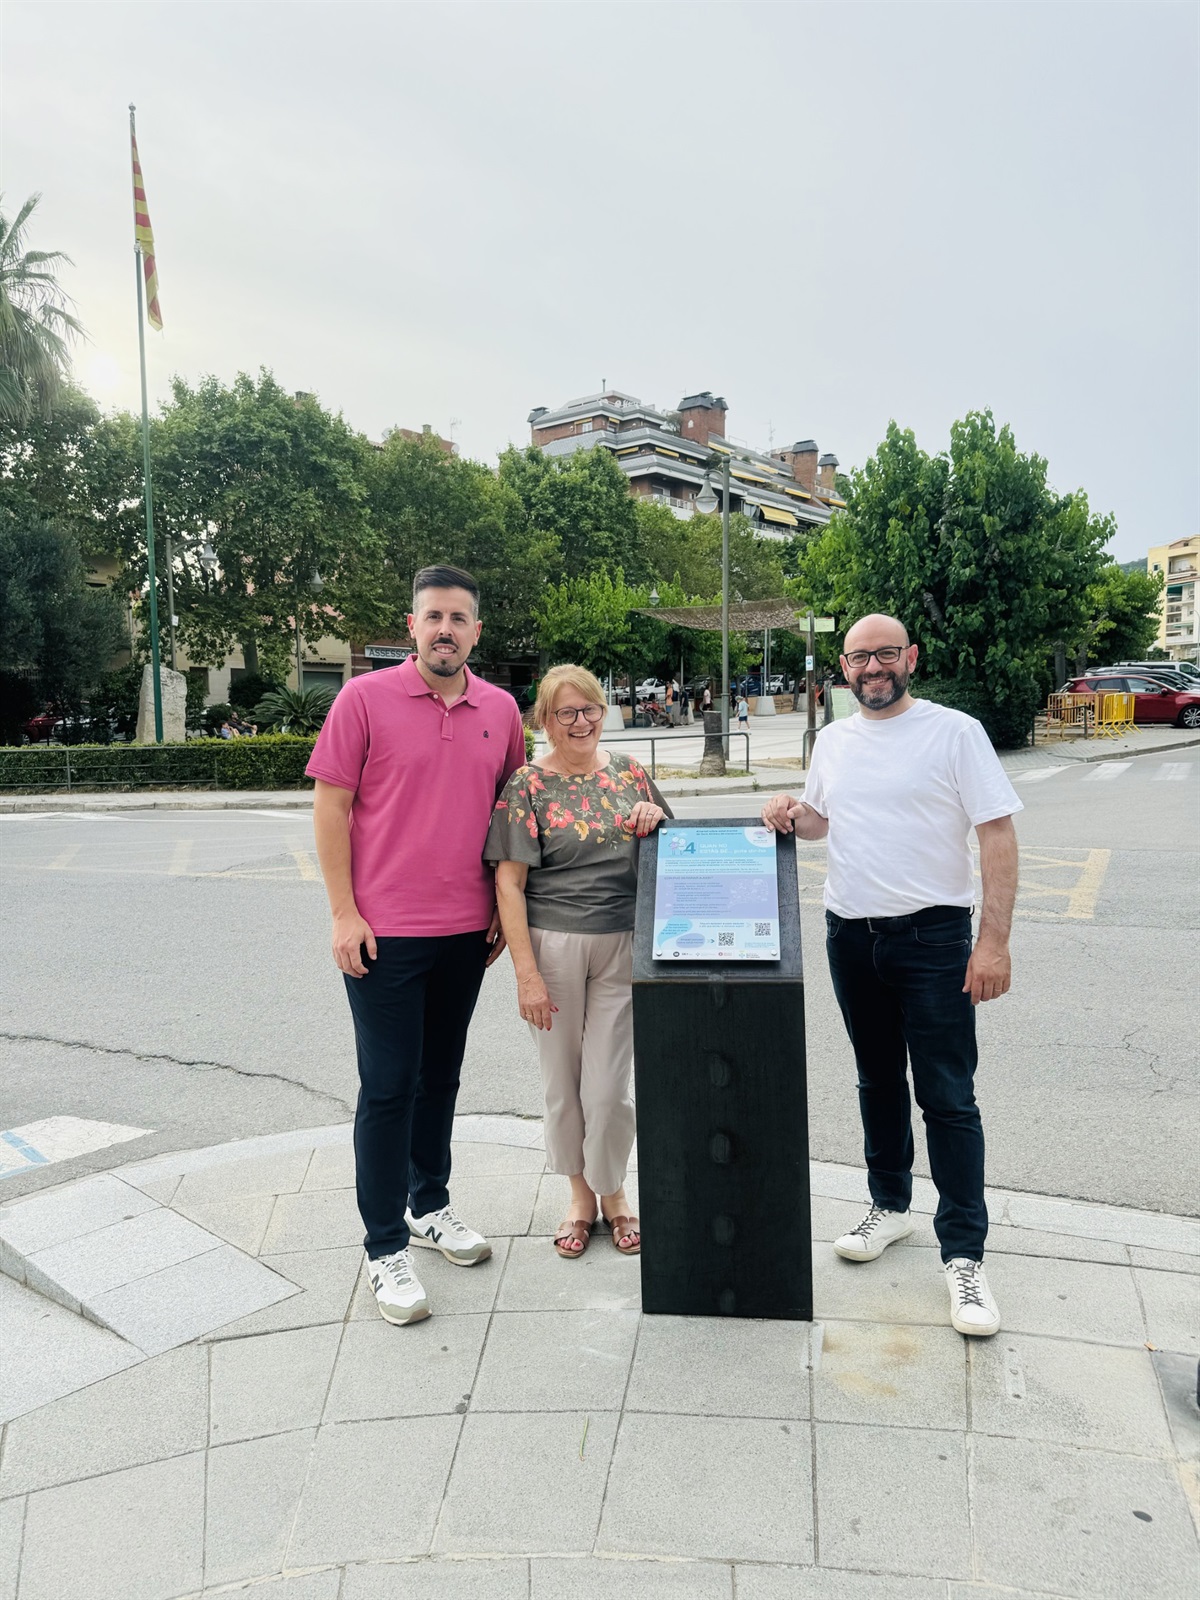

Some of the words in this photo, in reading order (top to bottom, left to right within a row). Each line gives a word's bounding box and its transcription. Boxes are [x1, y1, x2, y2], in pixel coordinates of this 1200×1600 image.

[684, 842, 696, 854] 4
[425, 1225, 443, 1244] N
[371, 1273, 384, 1294] N
